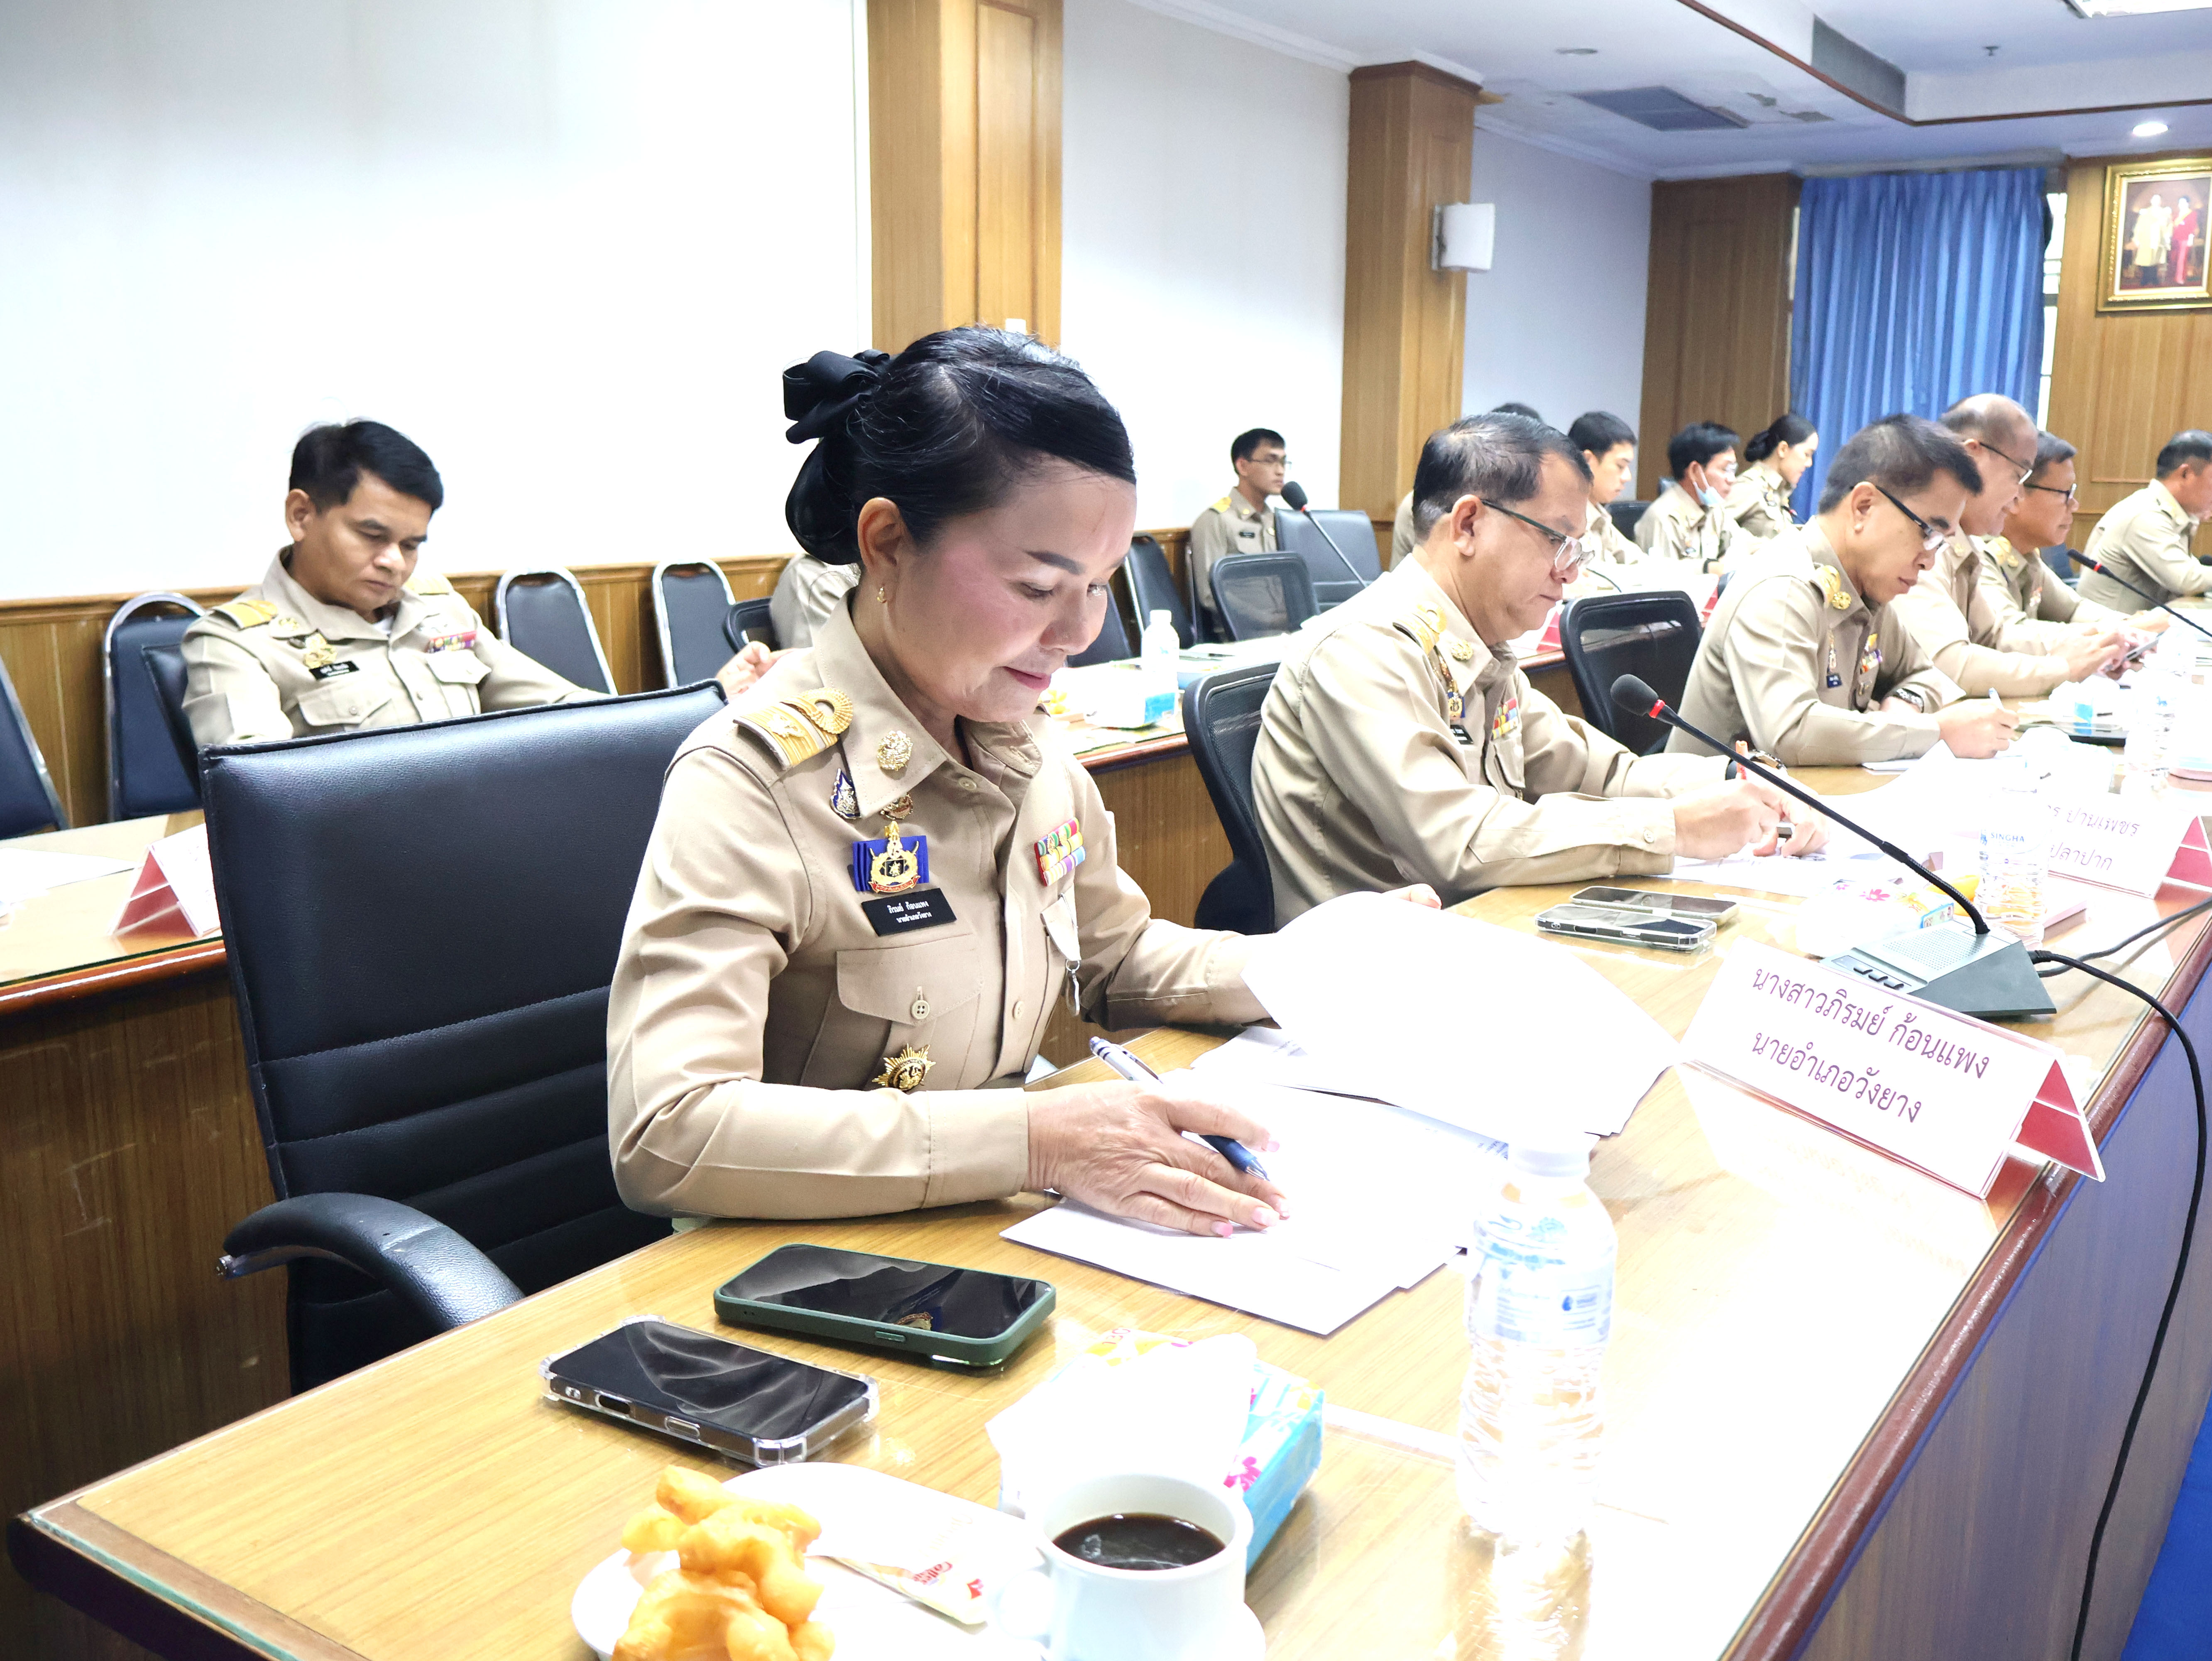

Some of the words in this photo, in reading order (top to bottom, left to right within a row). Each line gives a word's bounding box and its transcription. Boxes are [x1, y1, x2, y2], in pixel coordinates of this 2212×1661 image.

[1991, 832, 2024, 843] SINGHA
[1752, 968, 1894, 1036] นางสาวภิรมย์
[1888, 1012, 1989, 1079] ก้อนแพง
[1752, 1032, 1922, 1123] นายอำเภอวังยาง
